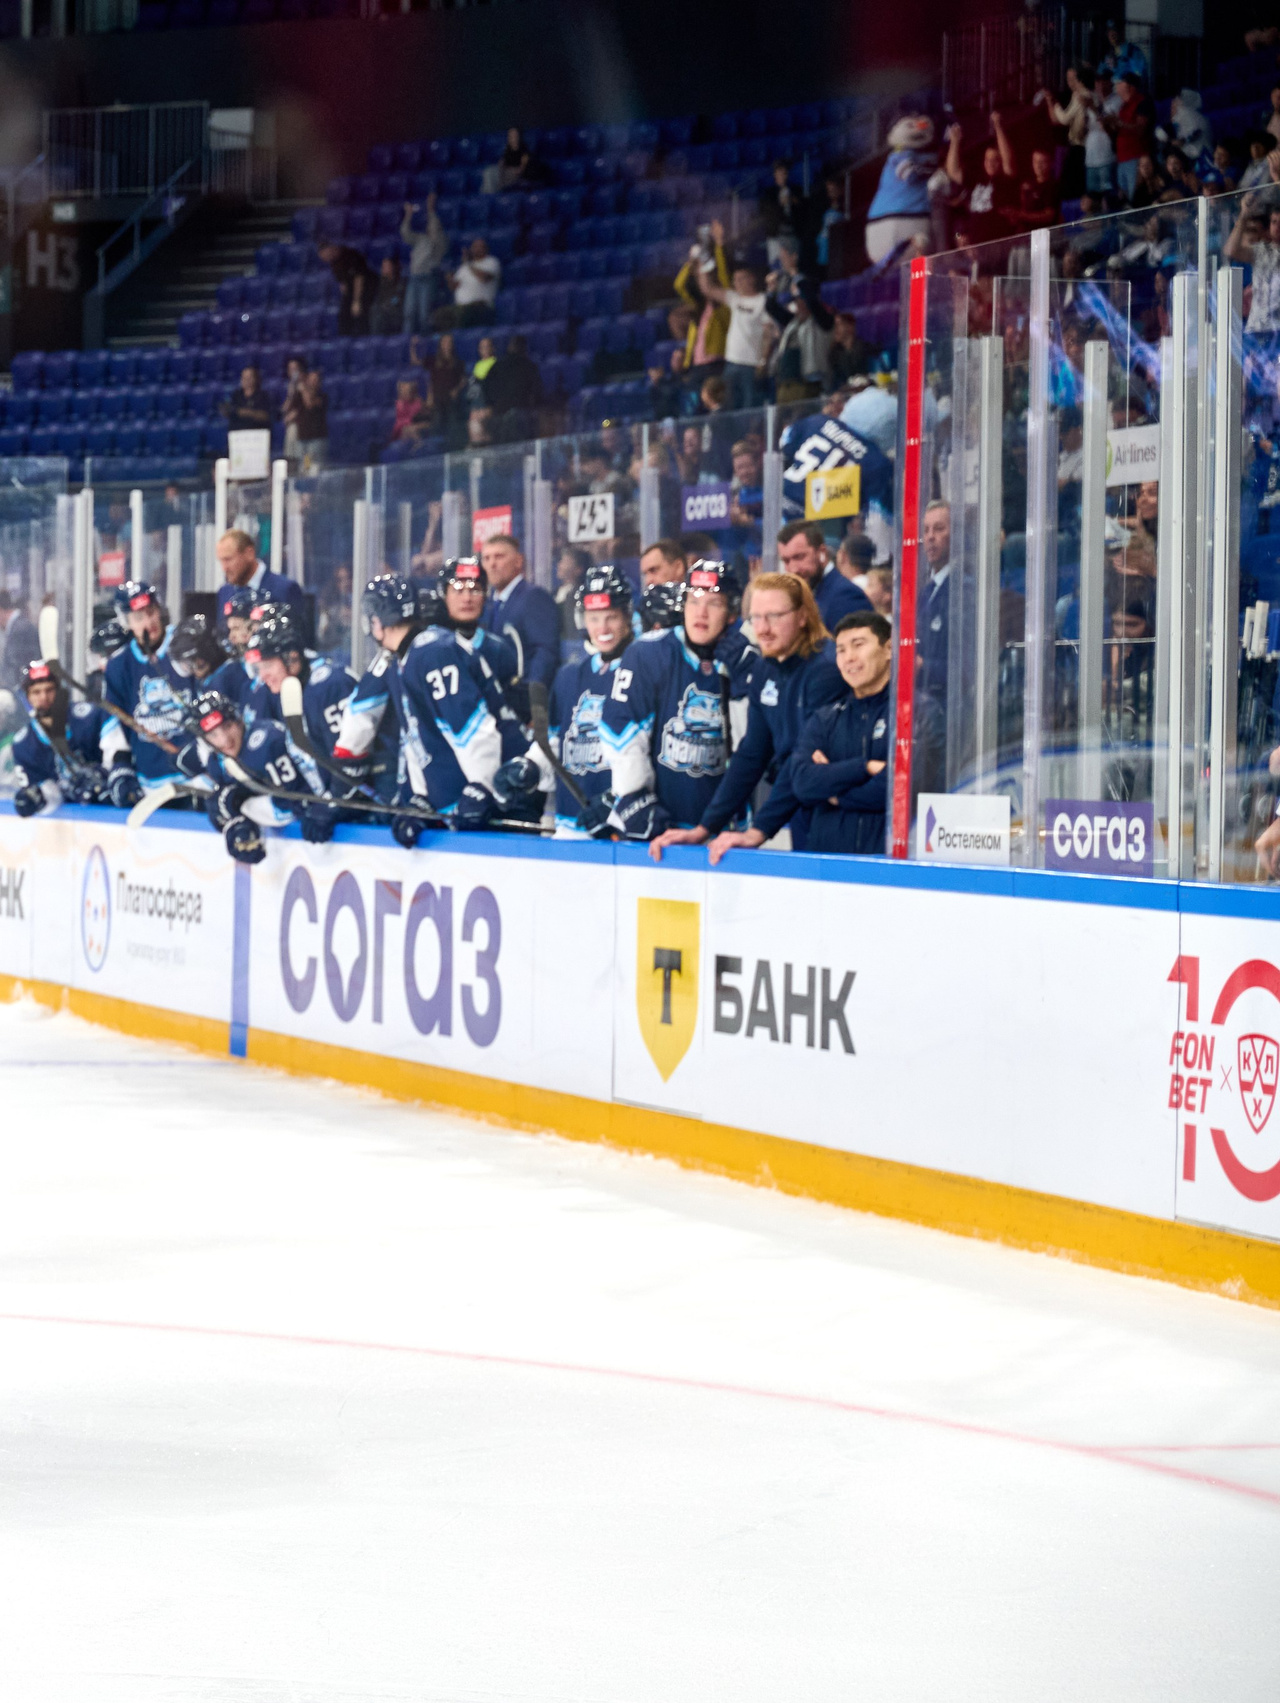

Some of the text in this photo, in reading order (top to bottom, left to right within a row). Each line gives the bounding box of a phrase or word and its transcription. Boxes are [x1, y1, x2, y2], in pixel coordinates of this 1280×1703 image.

[1114, 442, 1157, 467] Airlines
[425, 664, 460, 701] 37
[264, 756, 297, 787] 13
[937, 826, 1001, 851] Ростелеком
[713, 953, 858, 1057] БАНК
[1169, 1030, 1216, 1072] FON
[1167, 1073, 1213, 1115] BET
